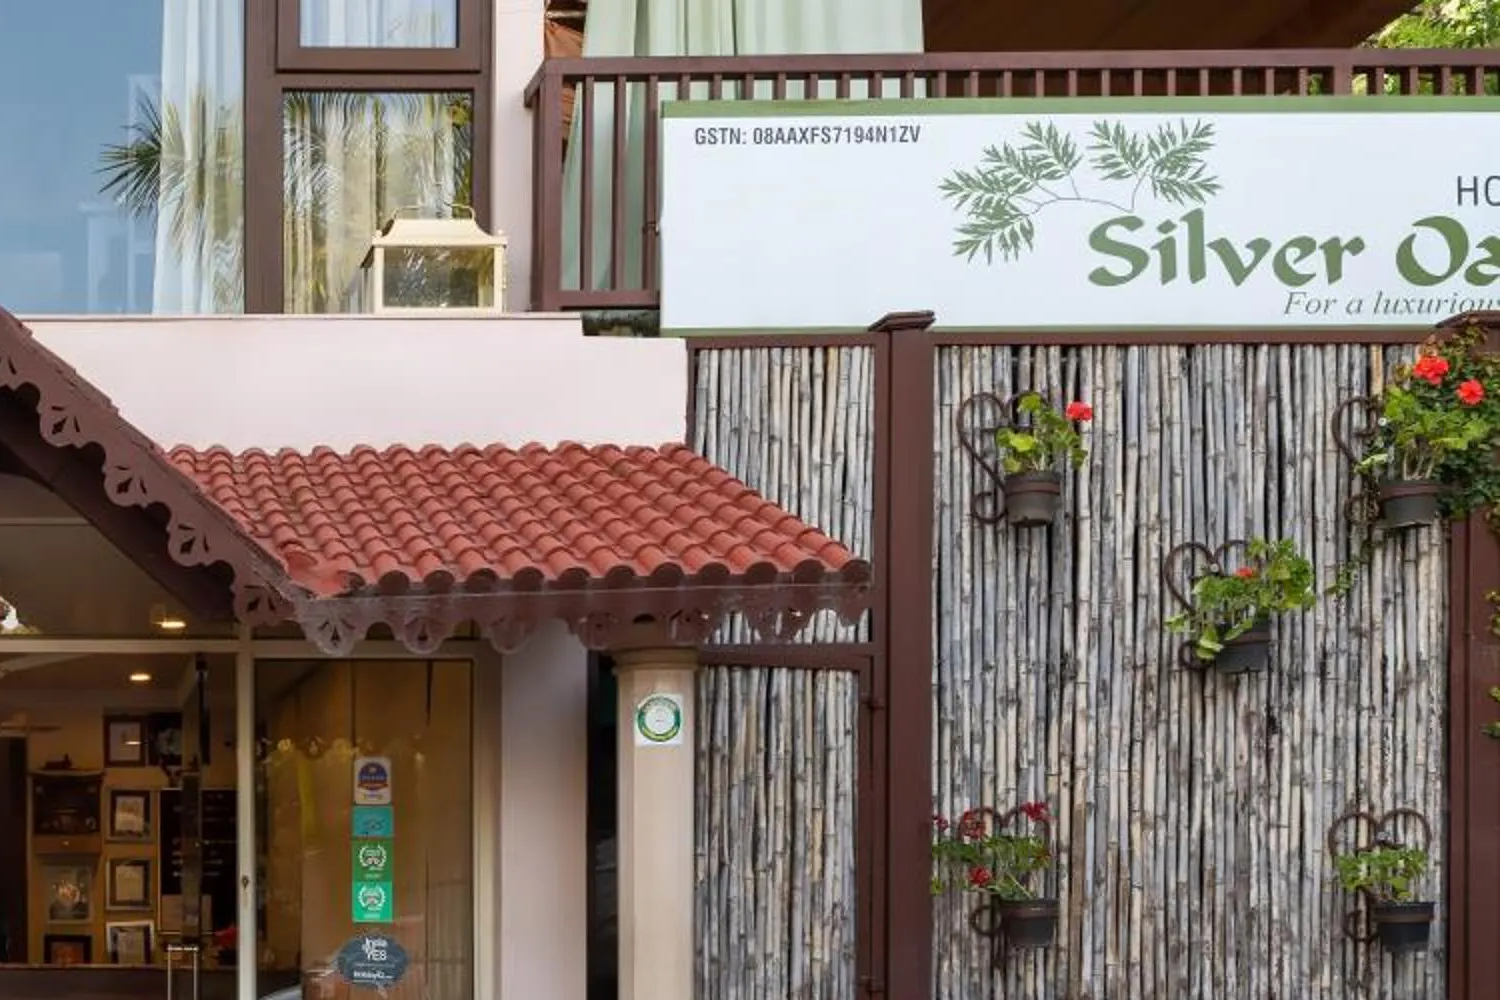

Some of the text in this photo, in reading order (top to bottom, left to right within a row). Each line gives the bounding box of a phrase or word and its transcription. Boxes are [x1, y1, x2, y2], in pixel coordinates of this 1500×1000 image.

[695, 125, 921, 145] GSTN: 08AAXFS7194N1ZV
[1088, 207, 1365, 287] Silver
[1283, 290, 1500, 316] For a luxuriou
